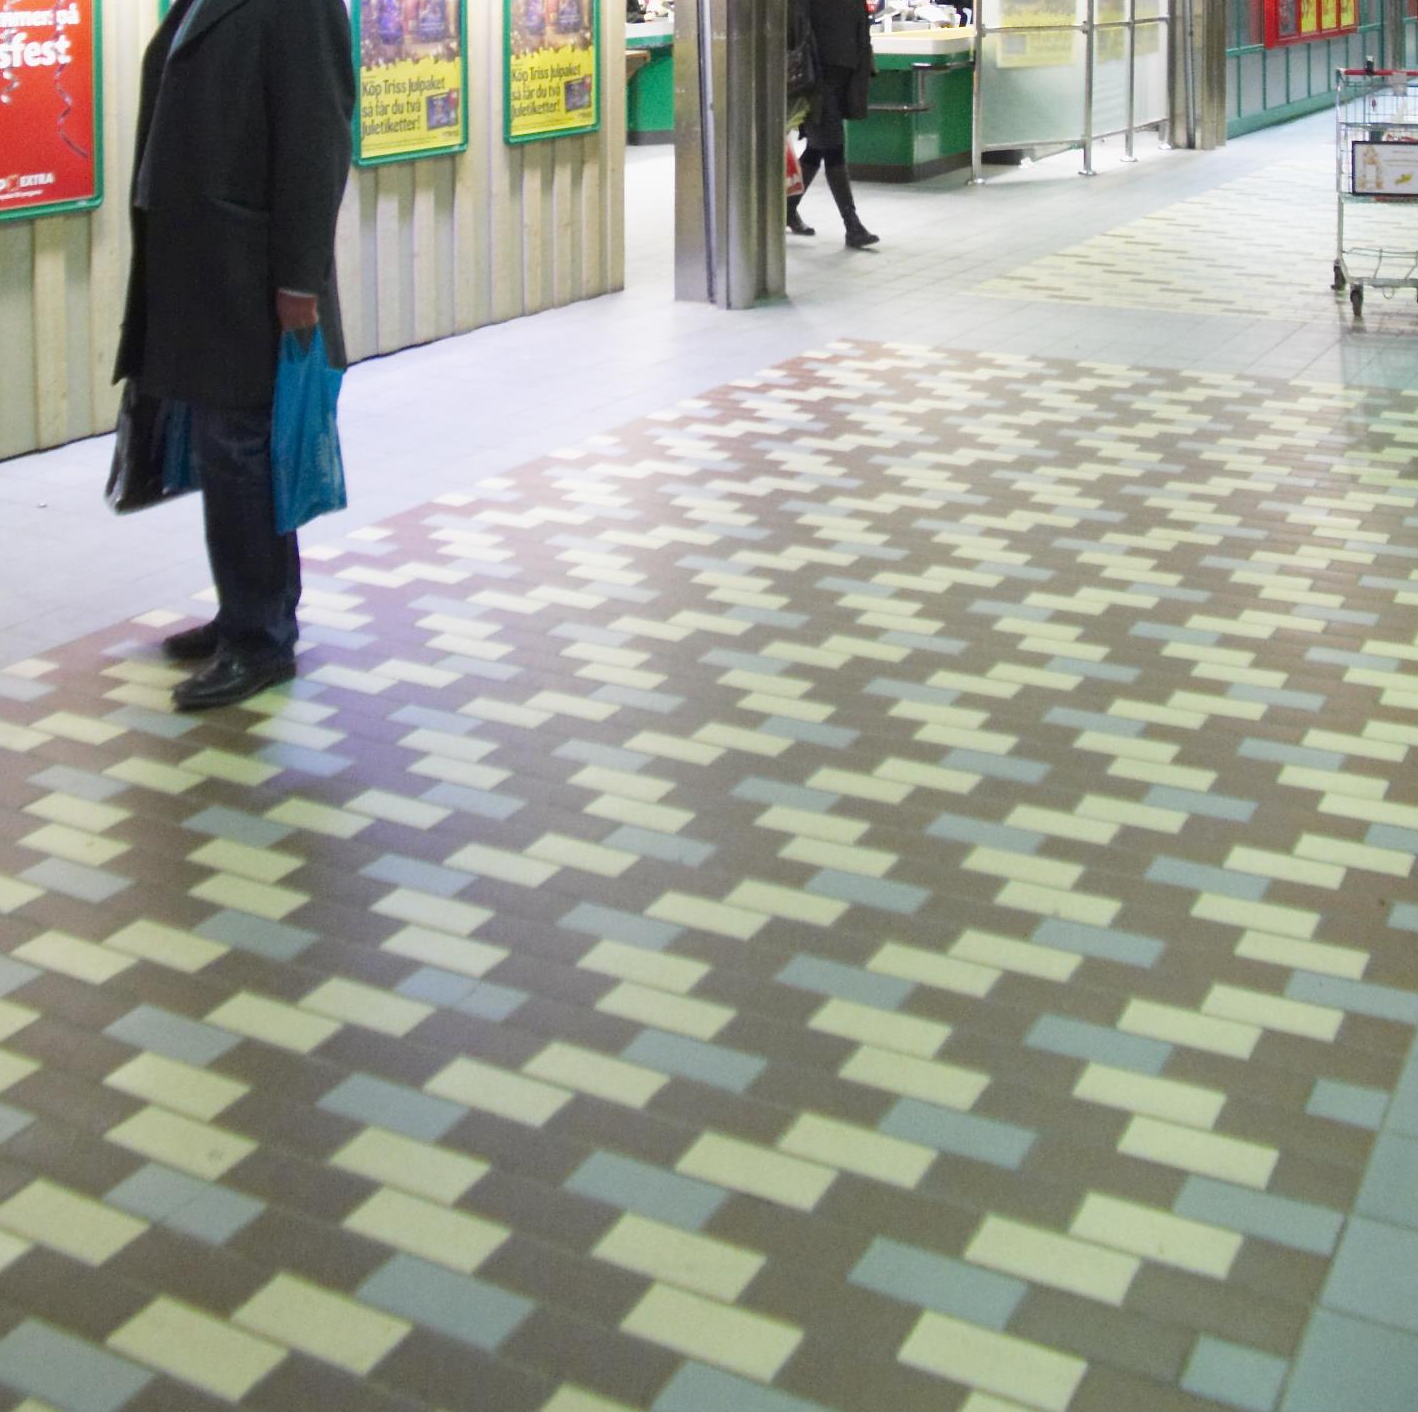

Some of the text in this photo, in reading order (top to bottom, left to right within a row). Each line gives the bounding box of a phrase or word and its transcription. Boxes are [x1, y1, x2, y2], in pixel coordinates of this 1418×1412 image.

[56, 2, 80, 31] på
[383, 78, 406, 94] Triss
[391, 98, 404, 115] du
[406, 97, 421, 114] två
